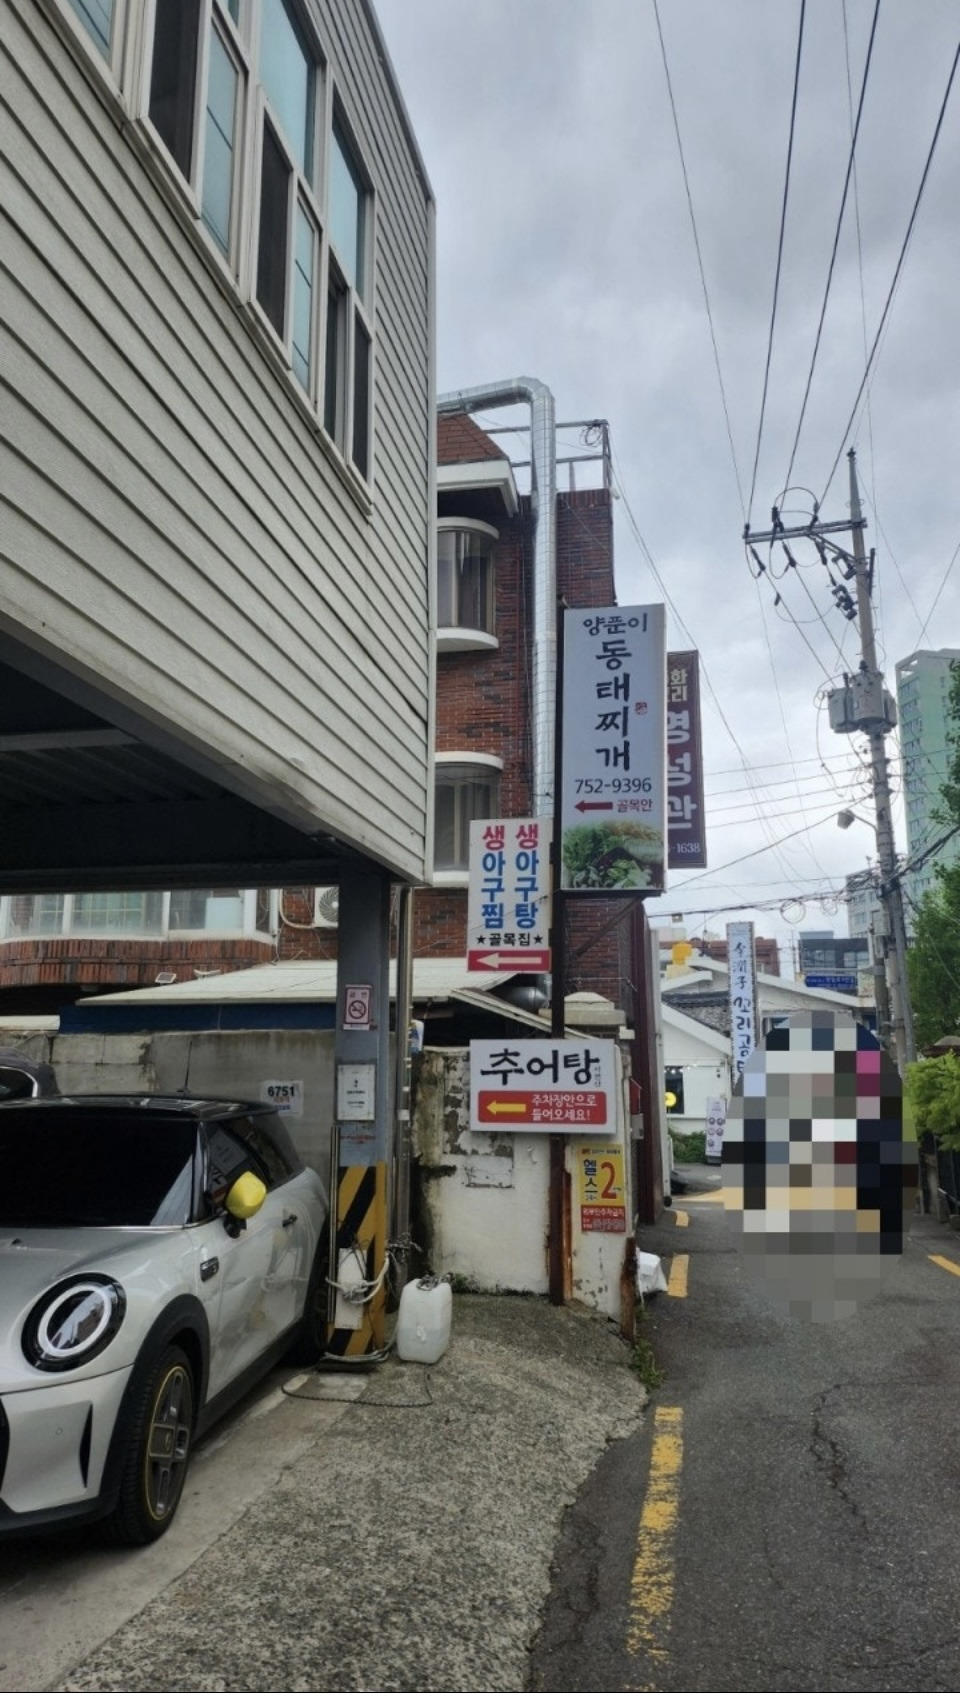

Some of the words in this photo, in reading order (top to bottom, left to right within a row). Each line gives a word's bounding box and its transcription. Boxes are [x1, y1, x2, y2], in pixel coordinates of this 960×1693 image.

[583, 613, 647, 637] 양푼이
[667, 668, 687, 685] 화
[667, 685, 688, 702] 리
[595, 639, 632, 771] 동태찌개
[575, 777, 652, 795] 752-9396
[616, 799, 653, 813] 골목안
[514, 823, 539, 930] 생아구탕
[489, 932, 531, 947] 골목집
[480, 1048, 600, 1086] 추어탕
[267, 1086, 295, 1097] 6751
[532, 1094, 597, 1108] 주차장안으로
[531, 1108, 590, 1121] 들어오세요!
[600, 1161, 617, 1200] 2
